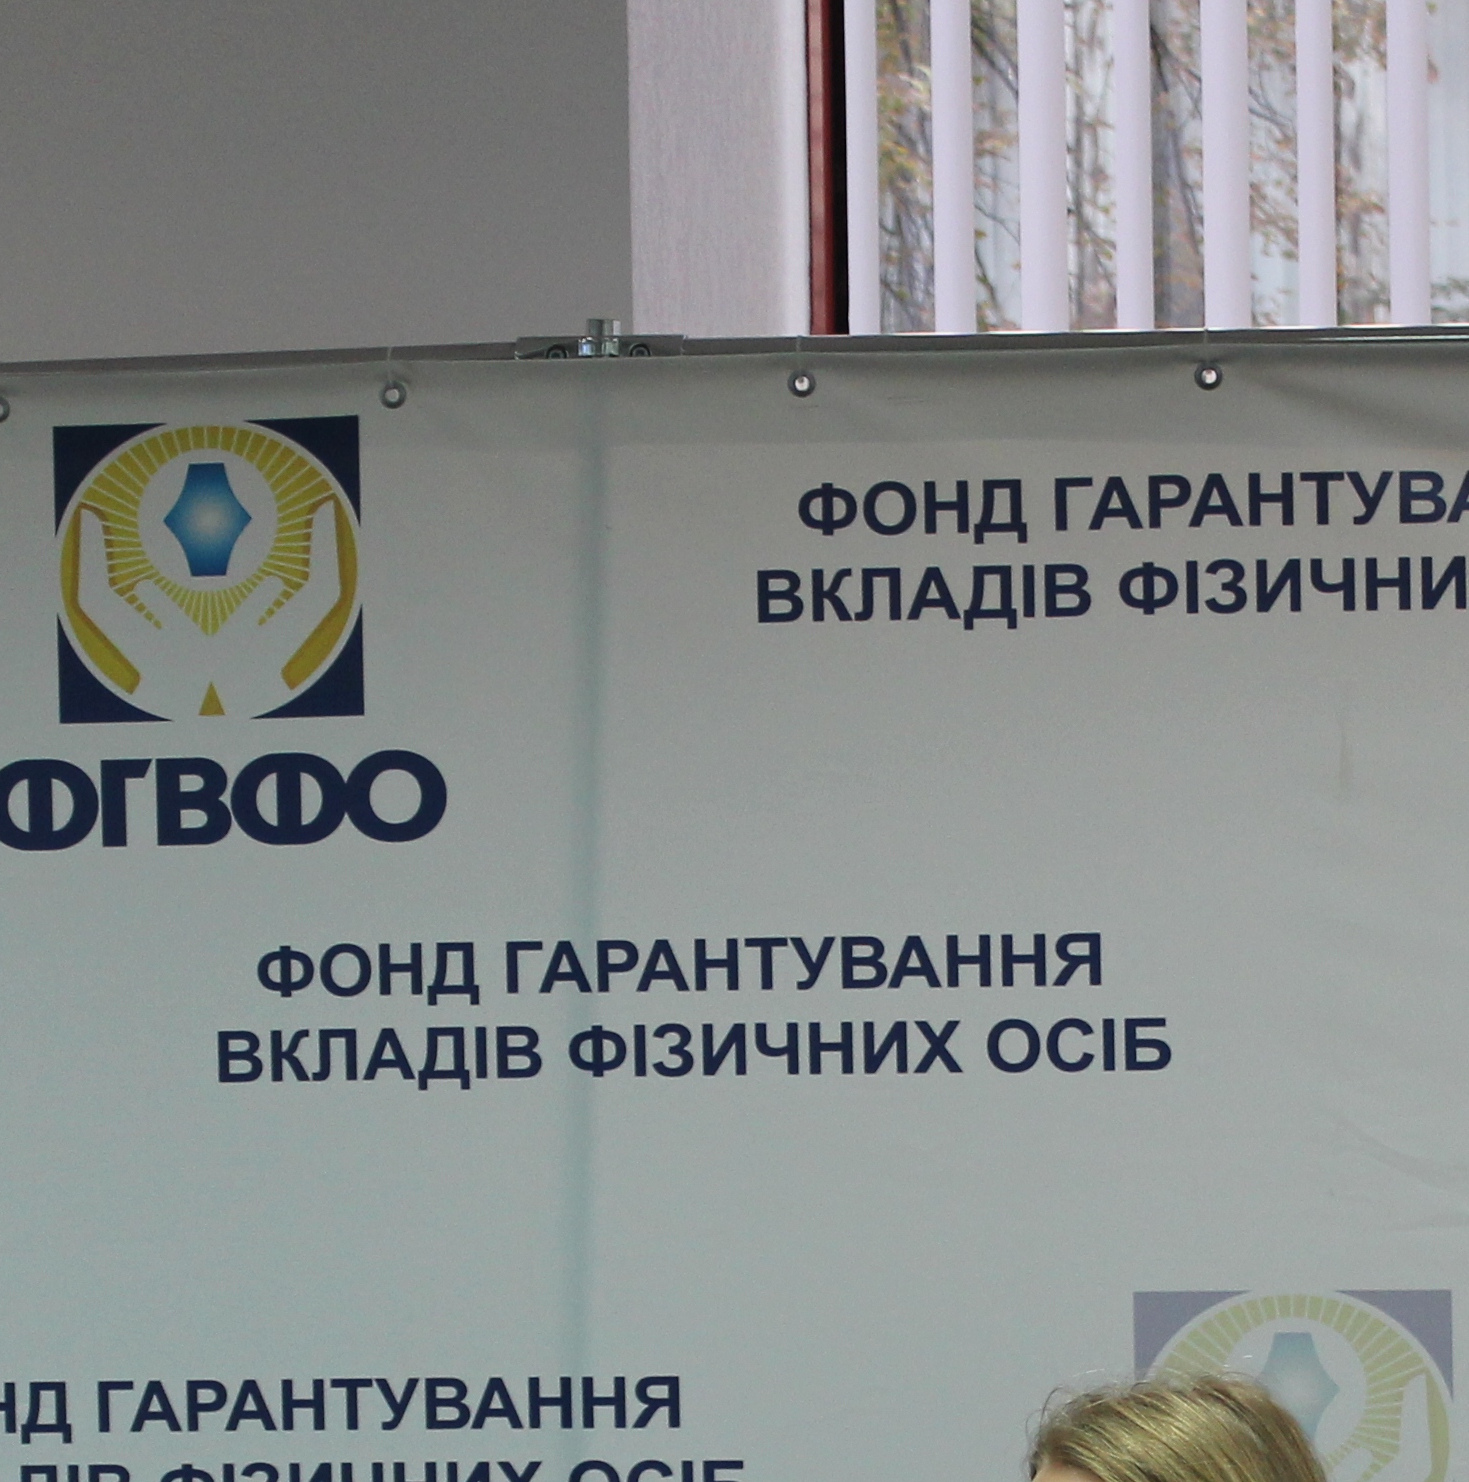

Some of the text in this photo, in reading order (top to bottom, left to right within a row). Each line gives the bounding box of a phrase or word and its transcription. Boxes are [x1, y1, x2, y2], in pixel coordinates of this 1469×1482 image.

[799, 479, 1027, 544] ФОНД
[757, 564, 1091, 630] ВКЛАДІВ
[258, 933, 1101, 1005] ФОНД ГАРАНТУВАННЯ
[218, 1018, 1171, 1090] ВКЛАДІВ ФІЗИЧНИХ ОСІБ
[98, 1376, 680, 1432] ГАРАНТУВАННЯ
